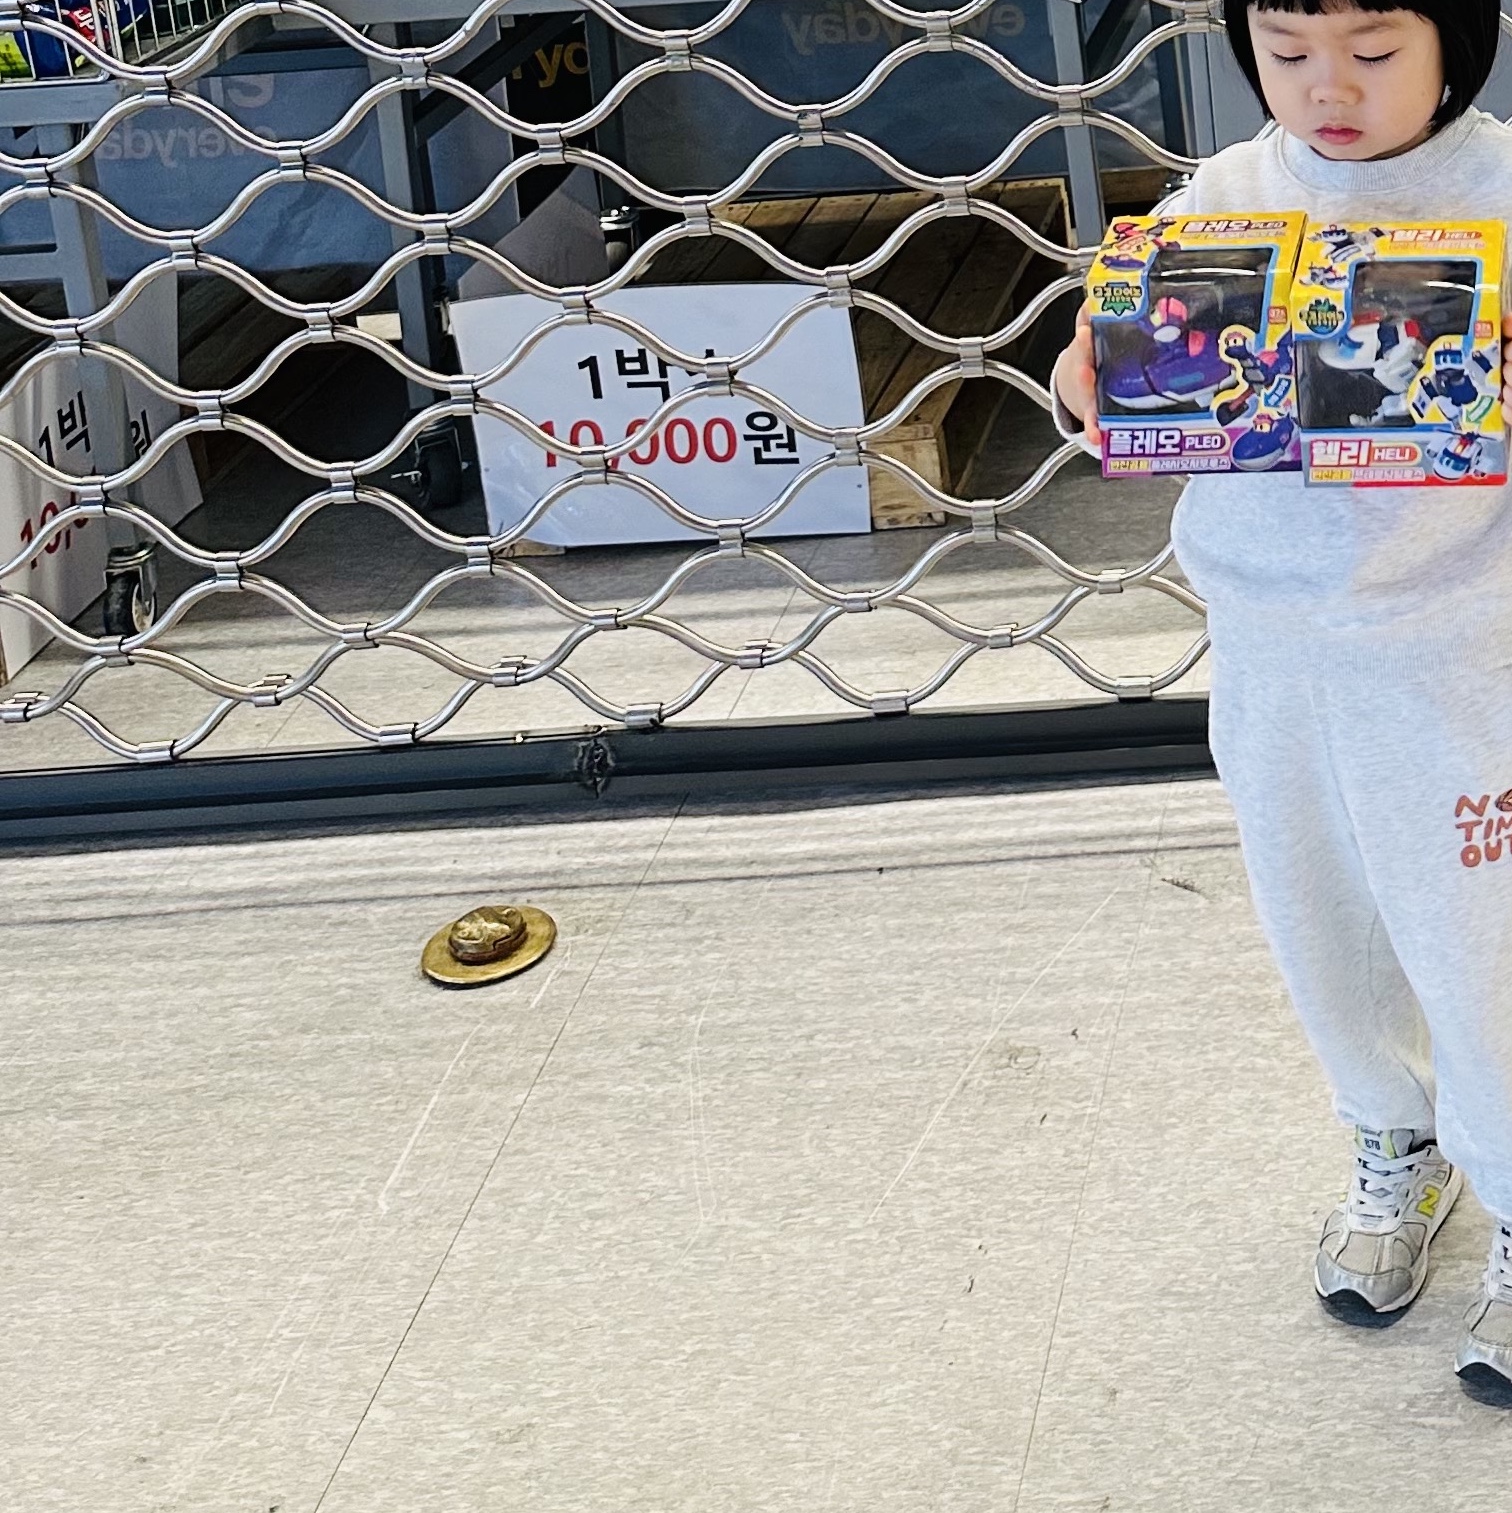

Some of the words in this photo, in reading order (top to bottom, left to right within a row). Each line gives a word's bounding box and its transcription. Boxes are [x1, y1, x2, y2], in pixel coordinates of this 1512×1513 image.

[1109, 429, 1183, 455] 플레오
[1186, 433, 1221, 449] PLEO
[1311, 440, 1371, 467] 헬리
[1373, 447, 1411, 462] HELI
